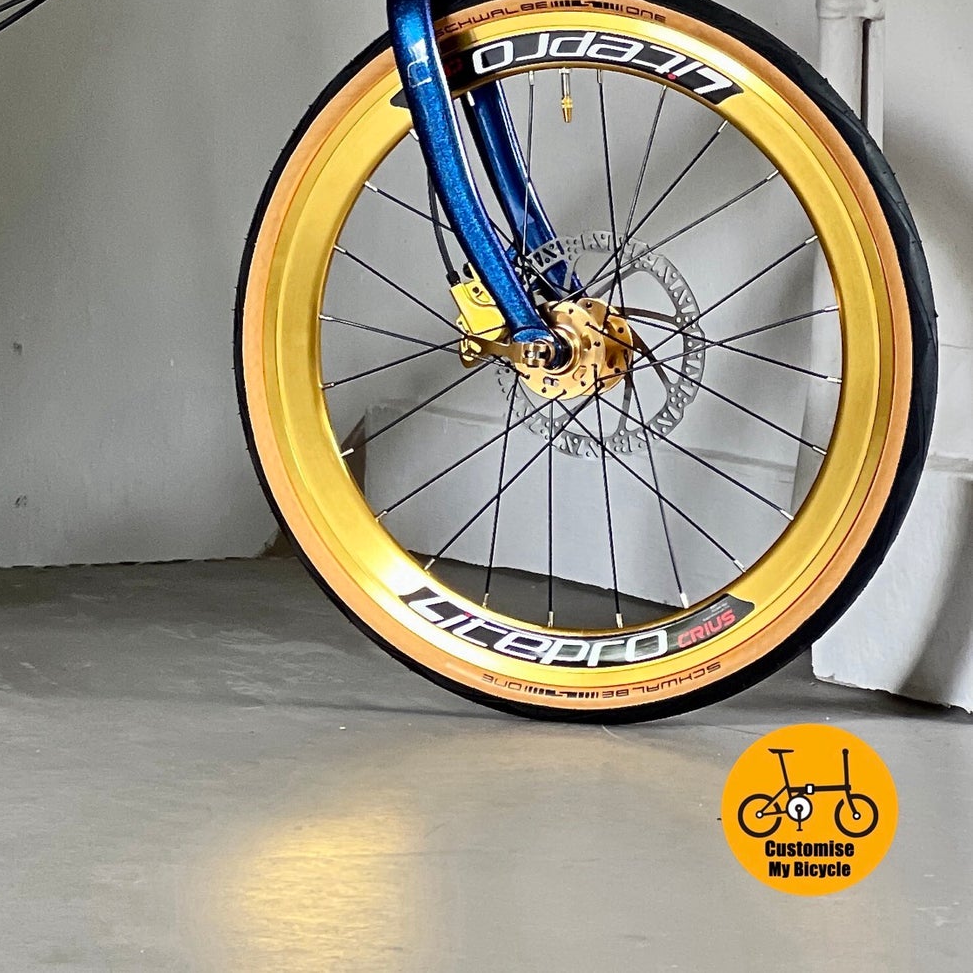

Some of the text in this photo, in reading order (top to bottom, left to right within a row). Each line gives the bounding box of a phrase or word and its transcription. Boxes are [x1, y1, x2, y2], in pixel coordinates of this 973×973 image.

[435, 0, 548, 38] SCHWALBE
[472, 32, 733, 94] Litepro
[408, 595, 736, 667] Litepro CRIUS
[602, 661, 721, 699] SCHWALBE
